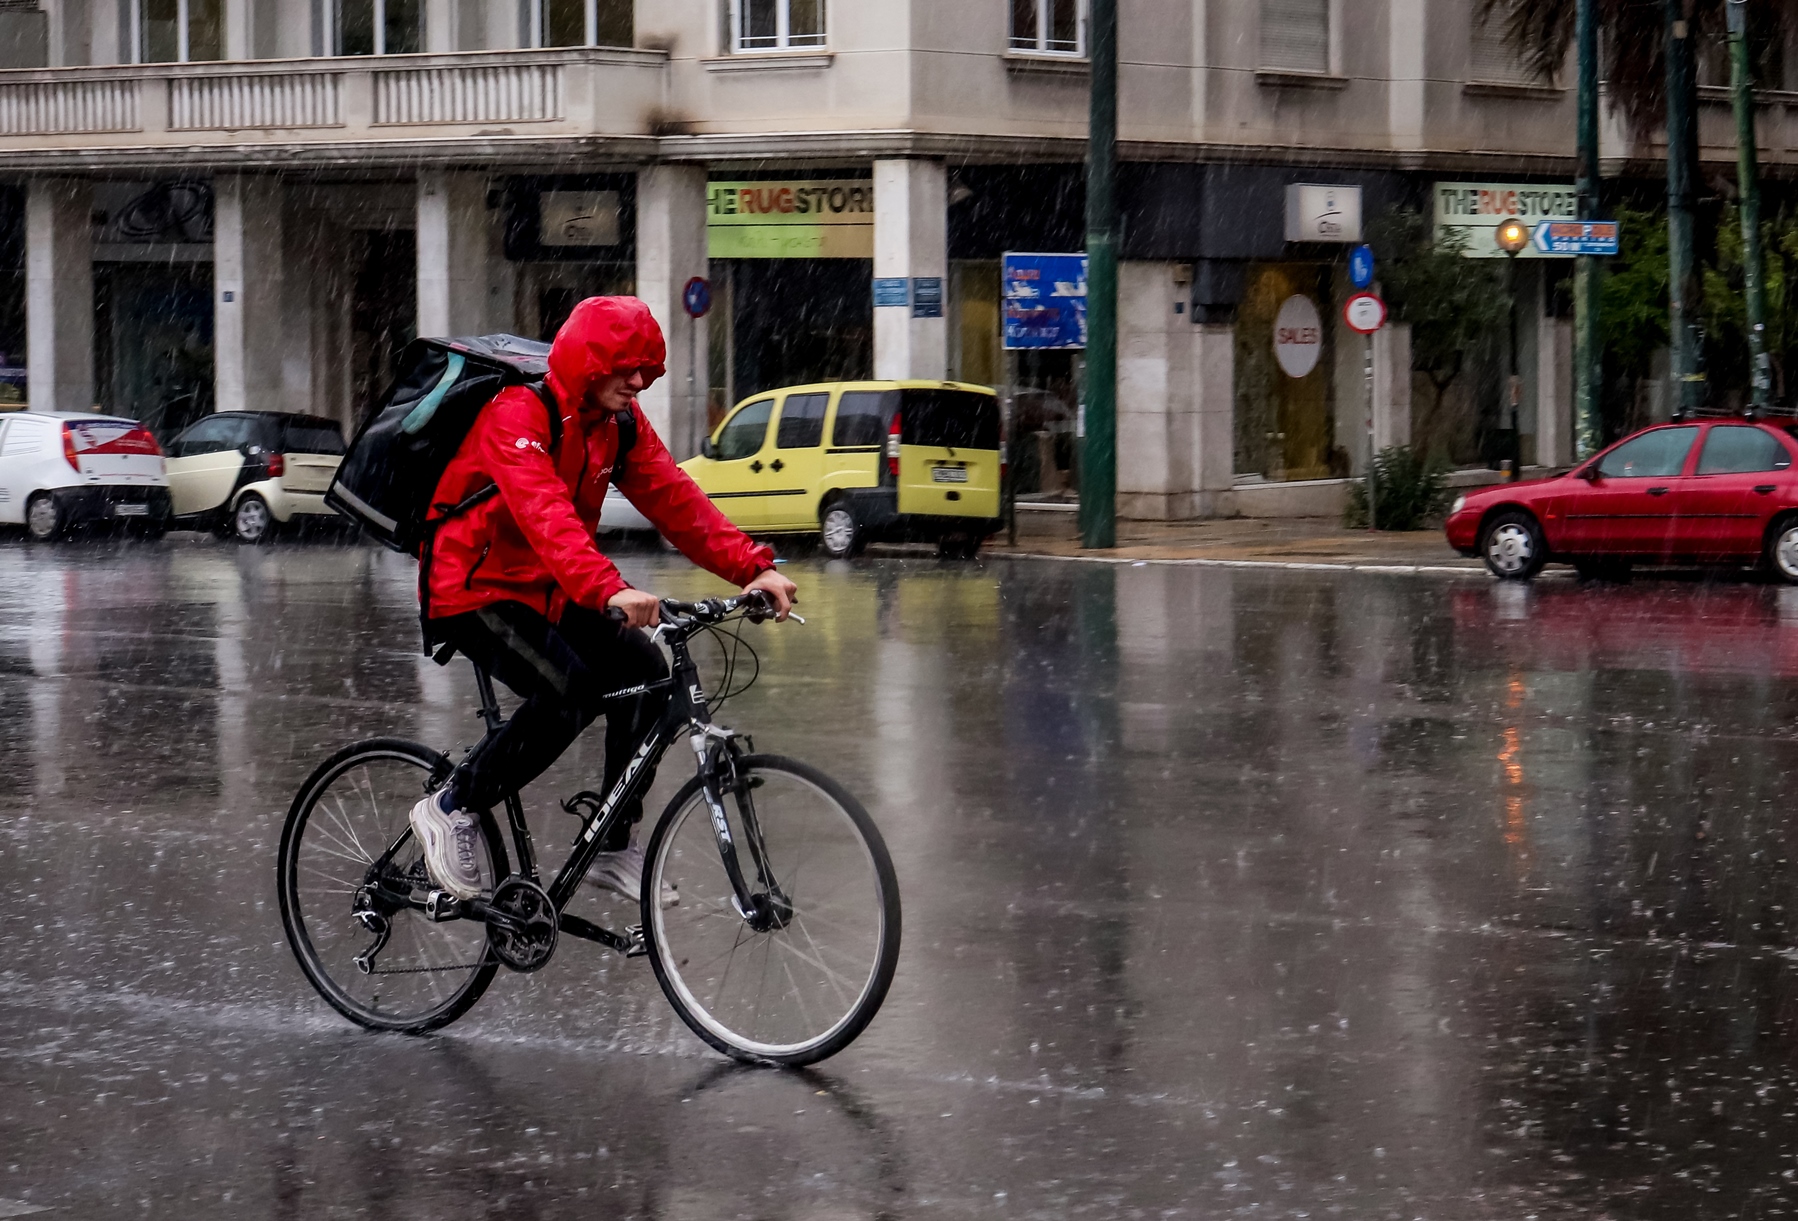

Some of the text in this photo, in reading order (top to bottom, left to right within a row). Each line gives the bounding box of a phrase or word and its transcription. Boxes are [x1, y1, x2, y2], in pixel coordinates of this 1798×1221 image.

[1278, 327, 1317, 345] SALES
[583, 733, 659, 843] IDEAL
[711, 803, 732, 843] RST
